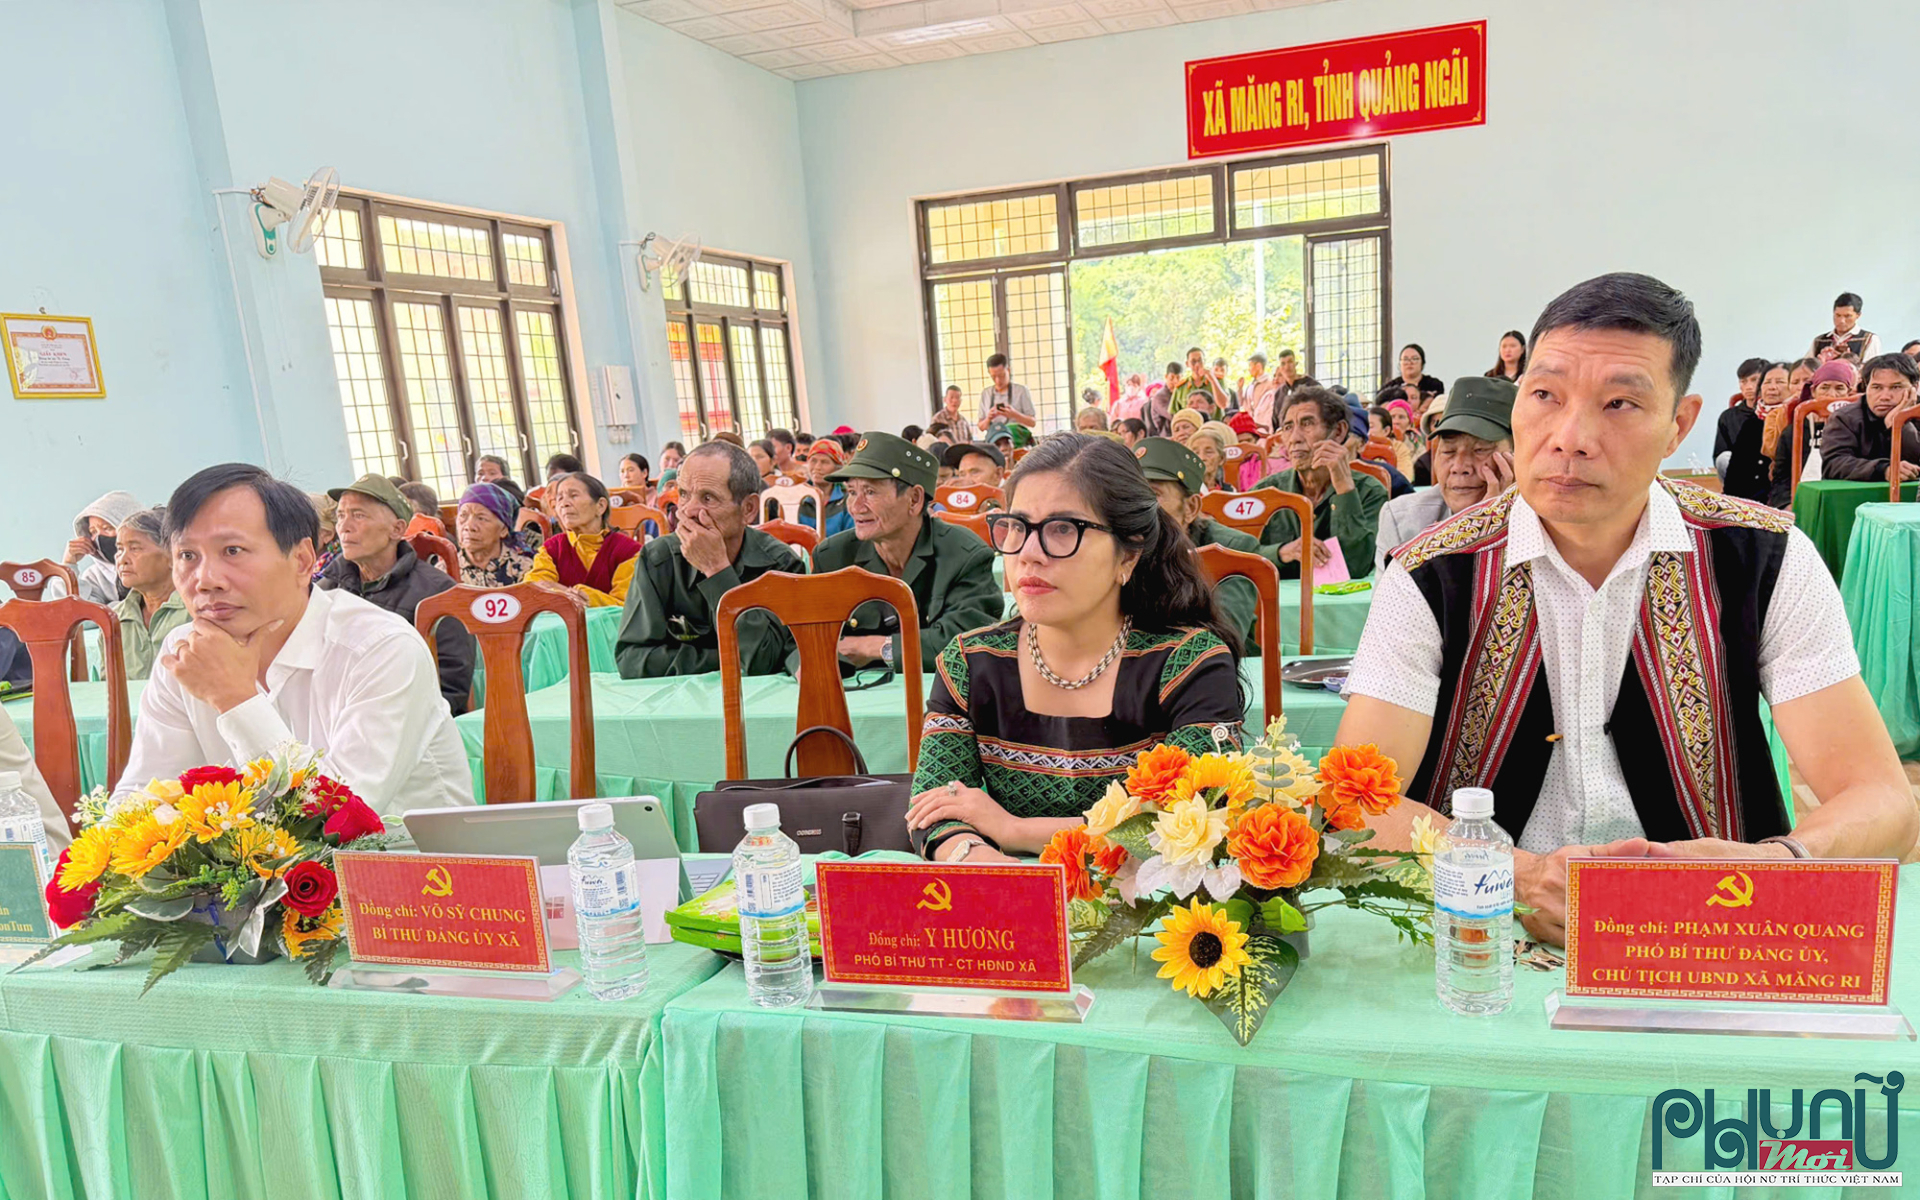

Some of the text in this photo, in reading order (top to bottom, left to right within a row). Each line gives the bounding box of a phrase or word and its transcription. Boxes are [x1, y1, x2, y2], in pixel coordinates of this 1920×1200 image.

[1202, 48, 1469, 137] XÃ MĂNG RI, TỈNH QUẢNG NGÃI
[956, 494, 969, 504] 84
[1235, 501, 1255, 515] 47
[21, 571, 36, 583] 85
[485, 598, 508, 618] 92
[359, 899, 527, 923] Đồng chí: VÕ SỸ CHUNG
[372, 923, 521, 947] BÍ THƯ ĐẢNG ỦY XÃ
[924, 927, 938, 948] Y
[943, 926, 1016, 951] HƯƠNG
[1594, 916, 1865, 939] Đồng chí: PHẠM XUÂN QUANG
[854, 952, 882, 966] PHÓ
[884, 953, 898, 967] BÍ
[900, 956, 927, 968] THƯ
[929, 957, 945, 969] TT
[956, 958, 974, 970] CT
[977, 959, 1015, 972] HĐND
[1018, 959, 1037, 973] XÃ
[1625, 941, 1829, 965] PHÓ BÍ THƯ ĐẢNG ỦY,
[1592, 963, 1861, 988] CHỦ TỊCH UBND XÃ MĂNG RI
